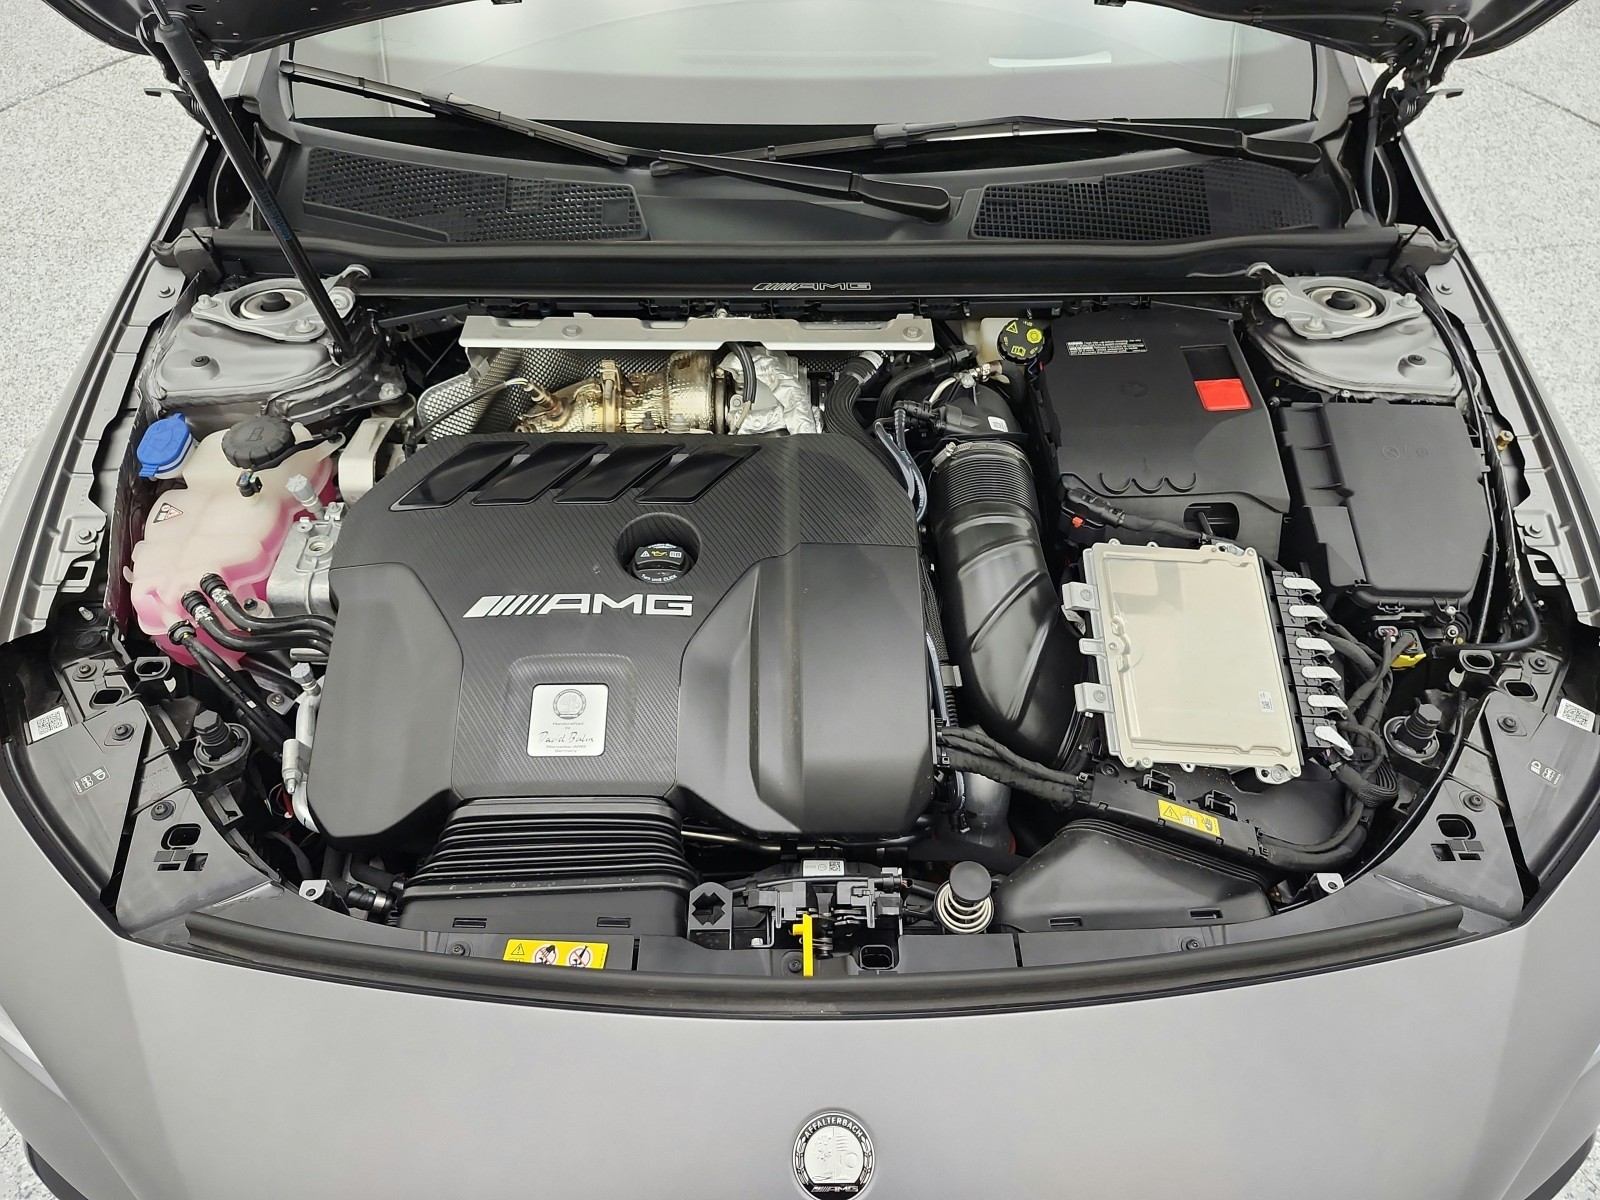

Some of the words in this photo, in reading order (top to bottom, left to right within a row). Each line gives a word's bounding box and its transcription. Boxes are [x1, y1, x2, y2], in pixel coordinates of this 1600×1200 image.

[793, 282, 872, 291] AMG
[537, 593, 693, 617] AMG
[804, 1116, 864, 1139] AFFALTERBACH
